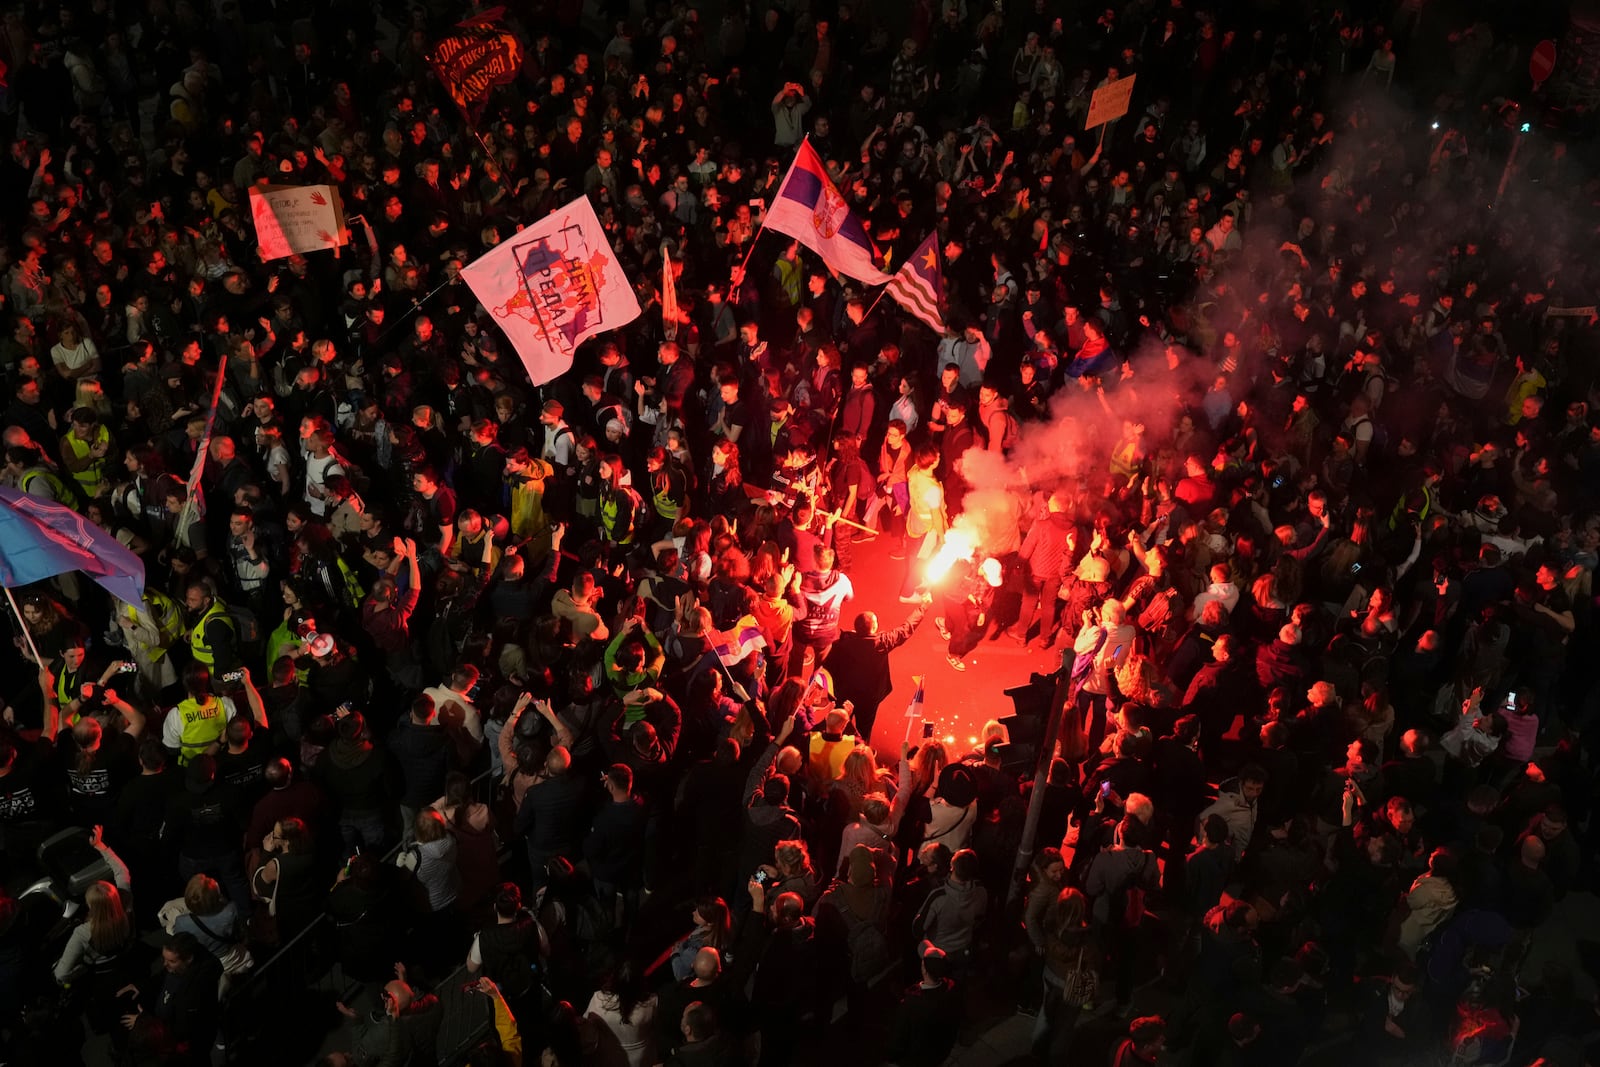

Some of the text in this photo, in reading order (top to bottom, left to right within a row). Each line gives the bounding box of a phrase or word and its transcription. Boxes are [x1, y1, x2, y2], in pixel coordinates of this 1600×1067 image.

[459, 45, 485, 69] TUKU
[529, 251, 567, 340] ПРЕДАЈЕ
[565, 256, 592, 308] НЕМА
